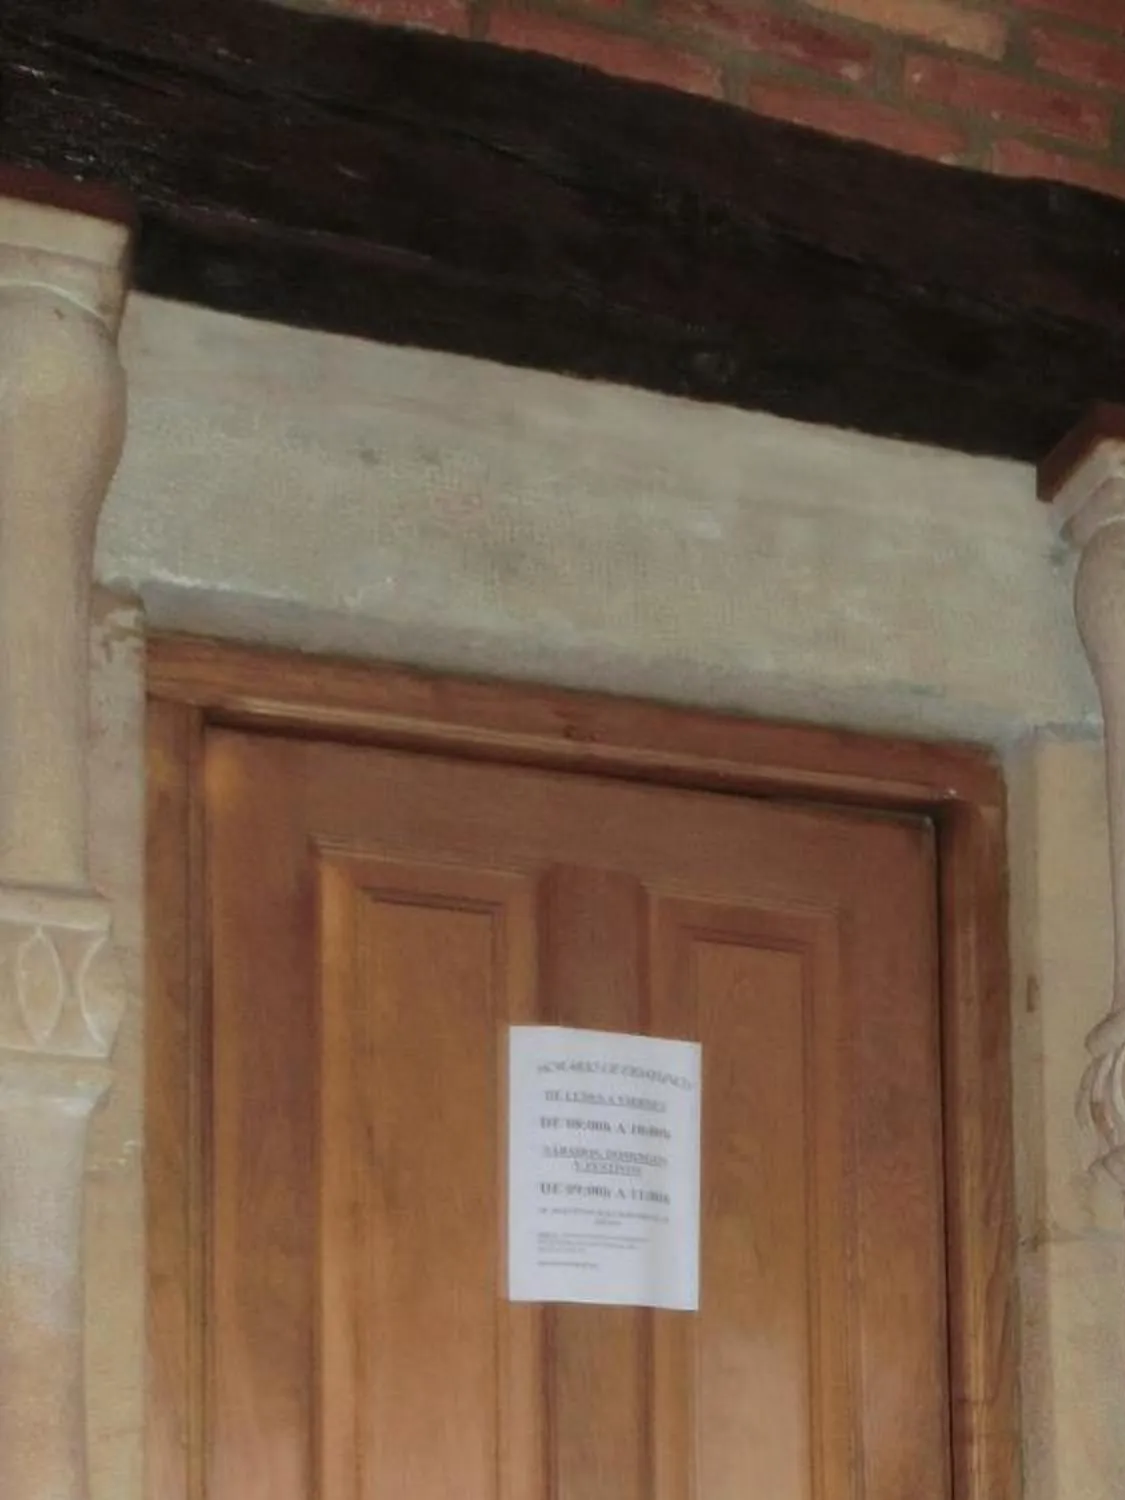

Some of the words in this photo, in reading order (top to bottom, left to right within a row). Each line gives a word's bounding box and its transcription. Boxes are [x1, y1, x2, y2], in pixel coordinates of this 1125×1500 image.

[540, 1116, 561, 1130] DE
[616, 1122, 627, 1135] A
[540, 1182, 561, 1196] DE
[616, 1186, 627, 1198] A
